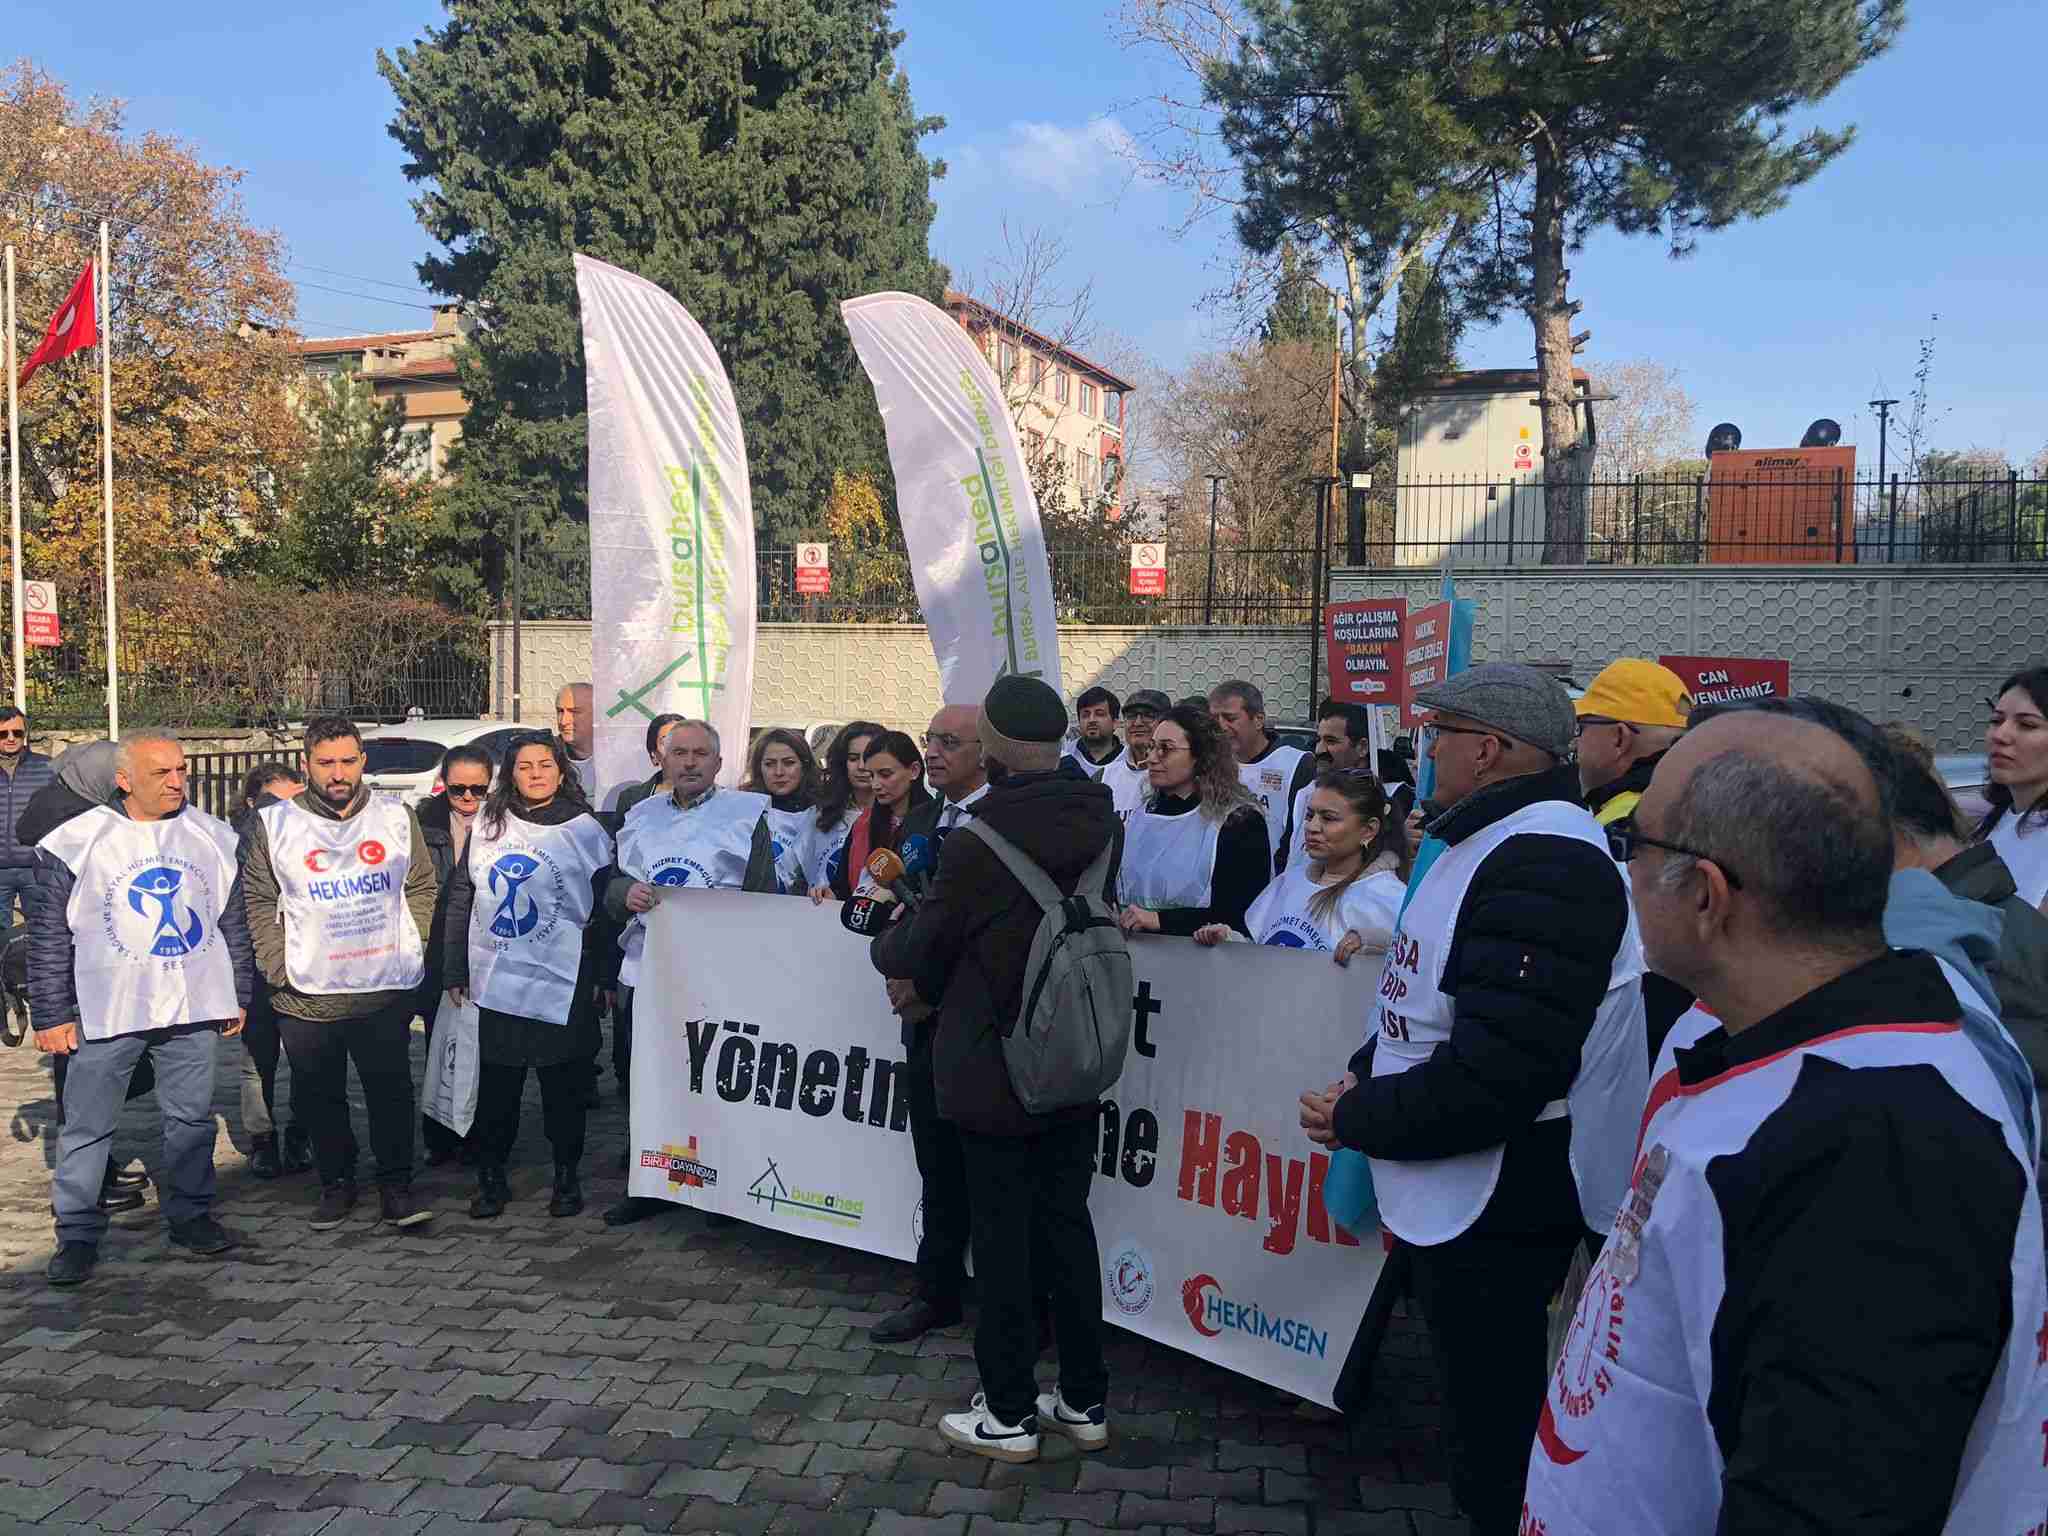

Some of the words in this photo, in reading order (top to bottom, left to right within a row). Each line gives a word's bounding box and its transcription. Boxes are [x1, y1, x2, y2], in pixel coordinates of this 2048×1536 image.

[664, 464, 695, 634] bursahed
[959, 473, 1008, 637] bursahed
[1018, 601, 1040, 662] BURSA
[1332, 611, 1354, 625] AĞIR
[1355, 610, 1399, 626] ÇALIŞMA
[1334, 627, 1399, 642] KOŞULLARINA
[1345, 659, 1390, 671] OLMAYIN.
[1698, 670, 1729, 685] CAN
[1689, 681, 1775, 705] VENLİĞİMİZ
[307, 871, 392, 902] HEKİMSEN
[1177, 1109, 1360, 1256] Hayı
[1207, 1294, 1329, 1360] HEKİMSEN
